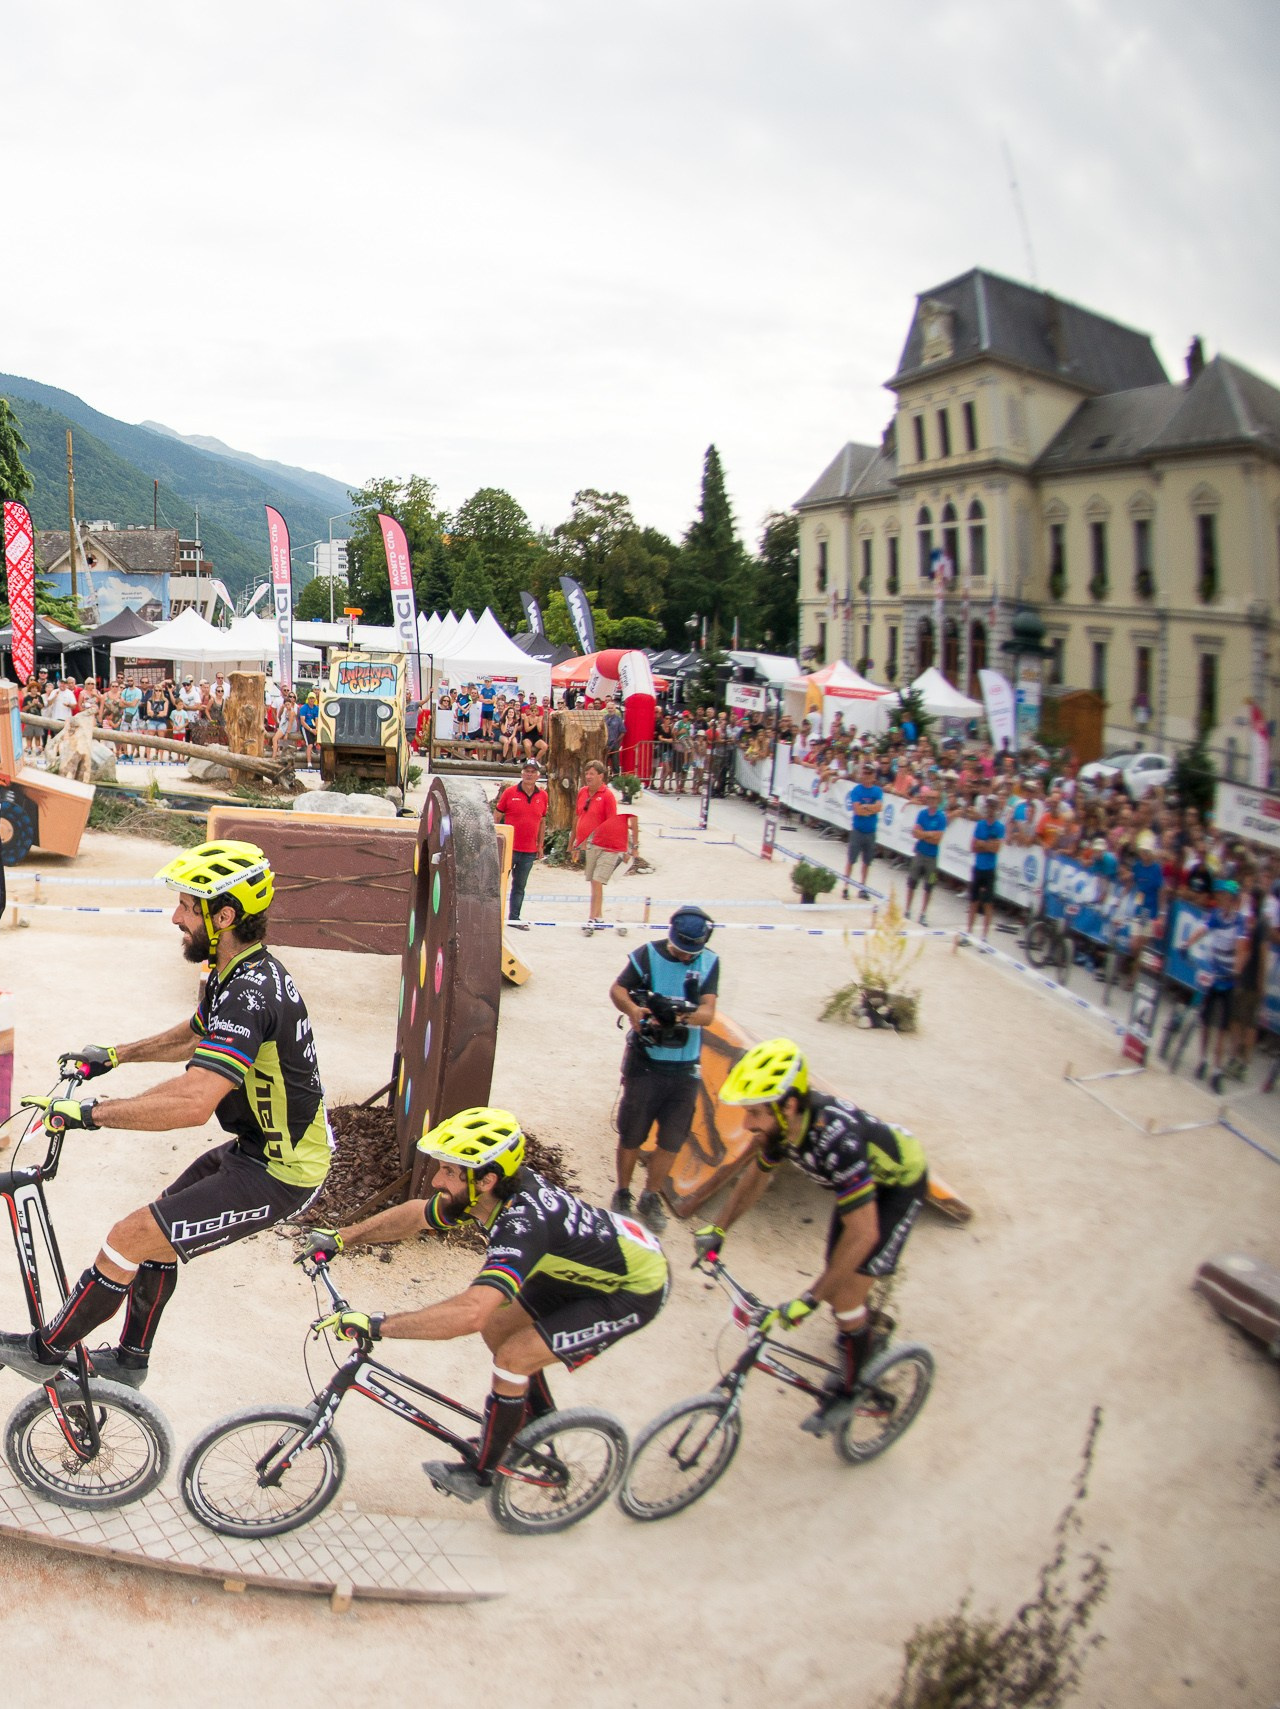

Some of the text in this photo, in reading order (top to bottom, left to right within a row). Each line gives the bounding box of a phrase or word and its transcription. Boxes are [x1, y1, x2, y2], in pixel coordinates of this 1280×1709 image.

[340, 666, 395, 685] INDIANA
[349, 678, 382, 694] CUP
[254, 1067, 286, 1160] heb
[171, 1205, 270, 1243] hebo
[97, 1276, 127, 1293] hebo
[553, 1313, 640, 1352] hebo
